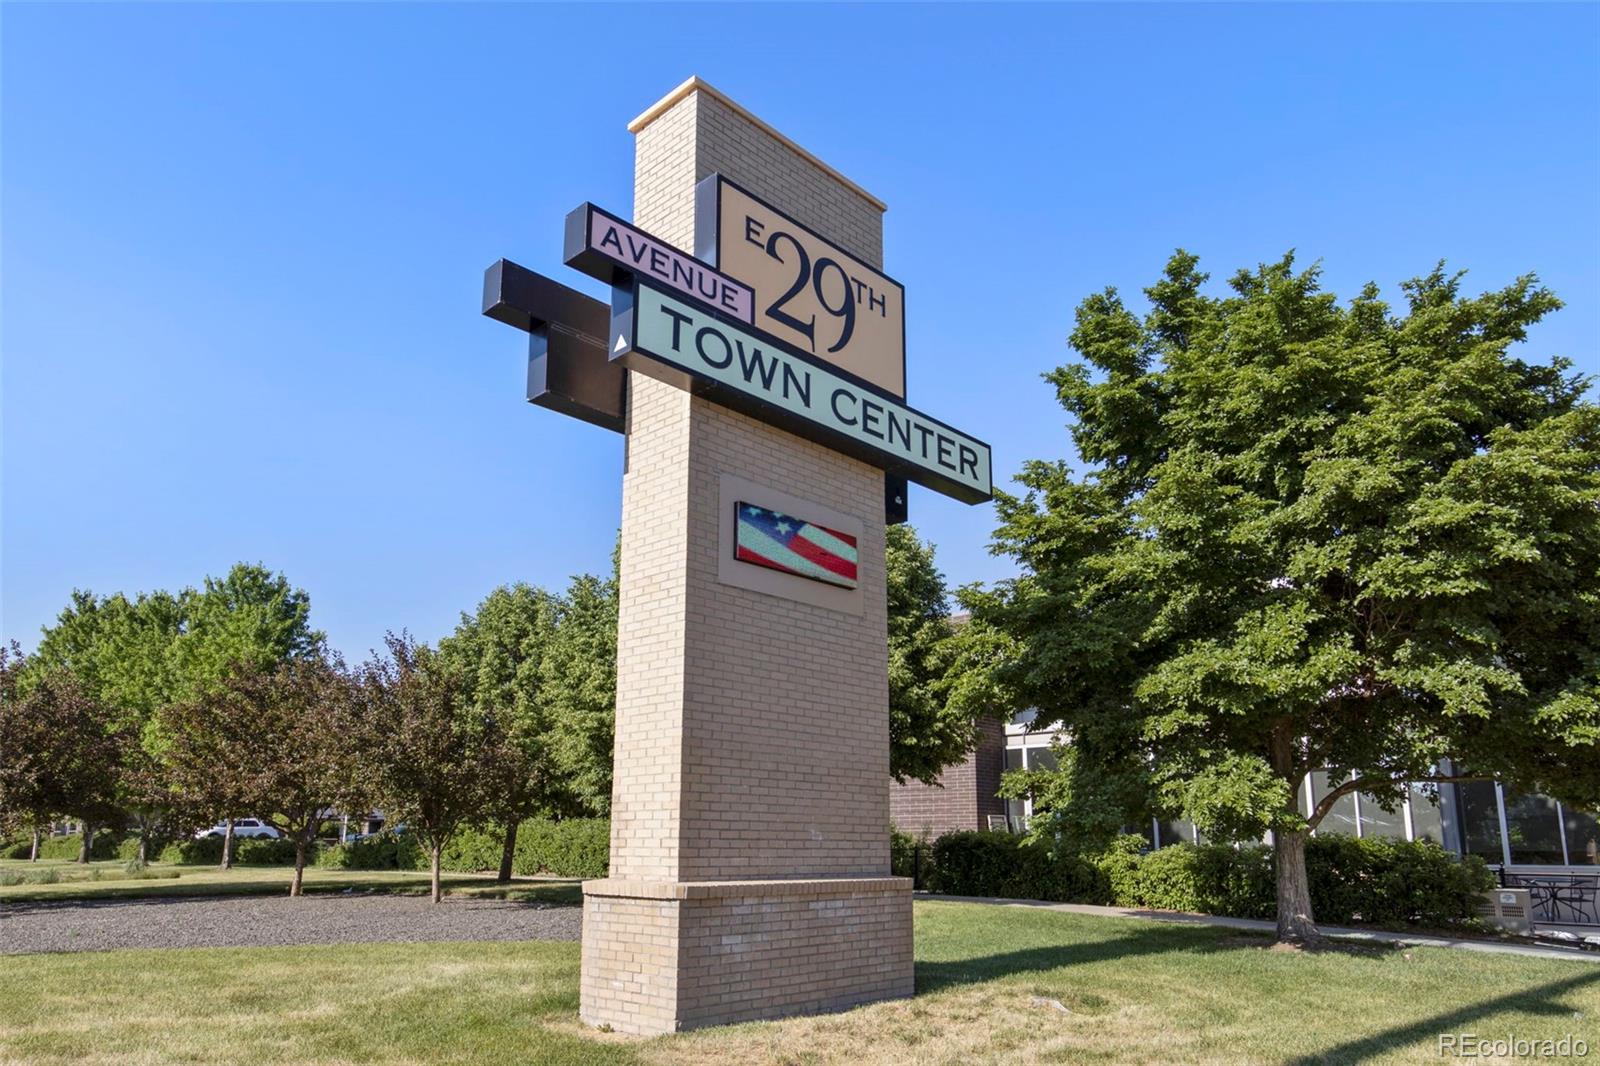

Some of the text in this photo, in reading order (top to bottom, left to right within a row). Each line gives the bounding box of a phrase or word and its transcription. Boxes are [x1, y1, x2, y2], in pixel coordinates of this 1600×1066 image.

[600, 226, 739, 312] AVENUE
[660, 304, 980, 480] TOWN CENTER
